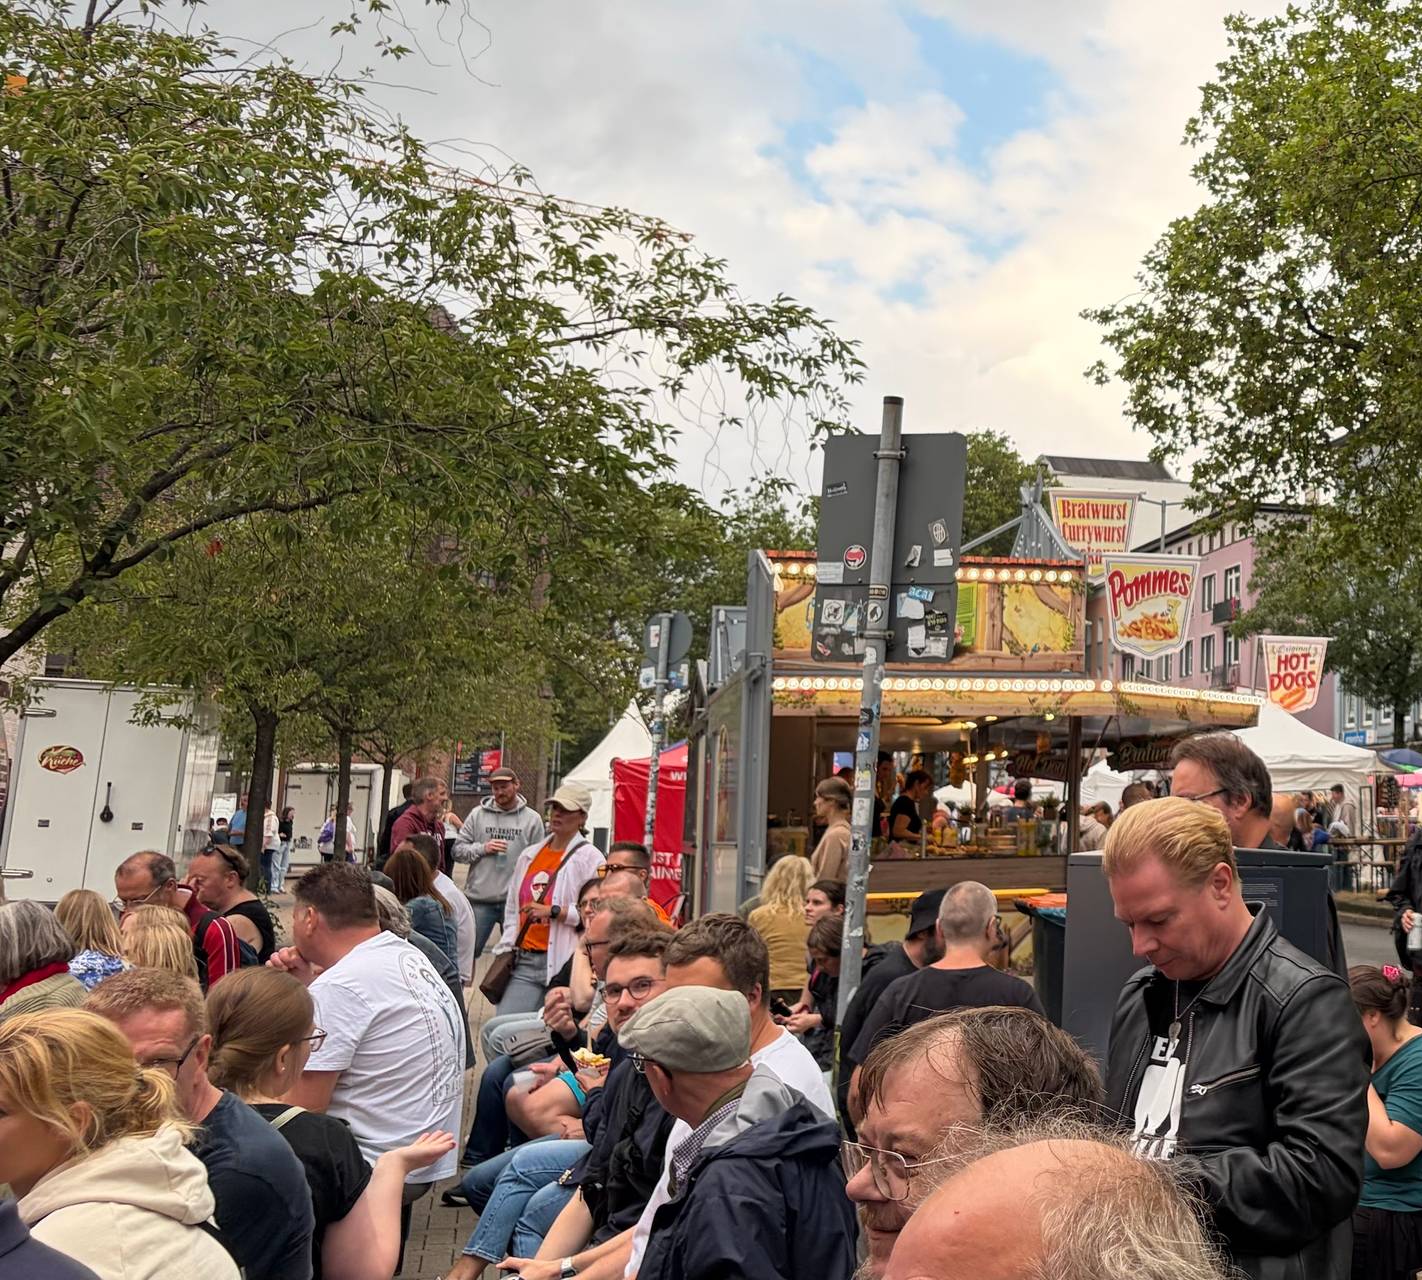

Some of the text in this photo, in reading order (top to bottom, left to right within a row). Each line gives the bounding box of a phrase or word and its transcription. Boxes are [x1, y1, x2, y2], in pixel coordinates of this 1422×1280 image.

[1061, 500, 1127, 520] Bratwurst
[1061, 522, 1127, 546] Currywurst
[1107, 568, 1191, 618] Pommes
[1277, 652, 1316, 673] HOT-
[1269, 670, 1317, 692] DOGS
